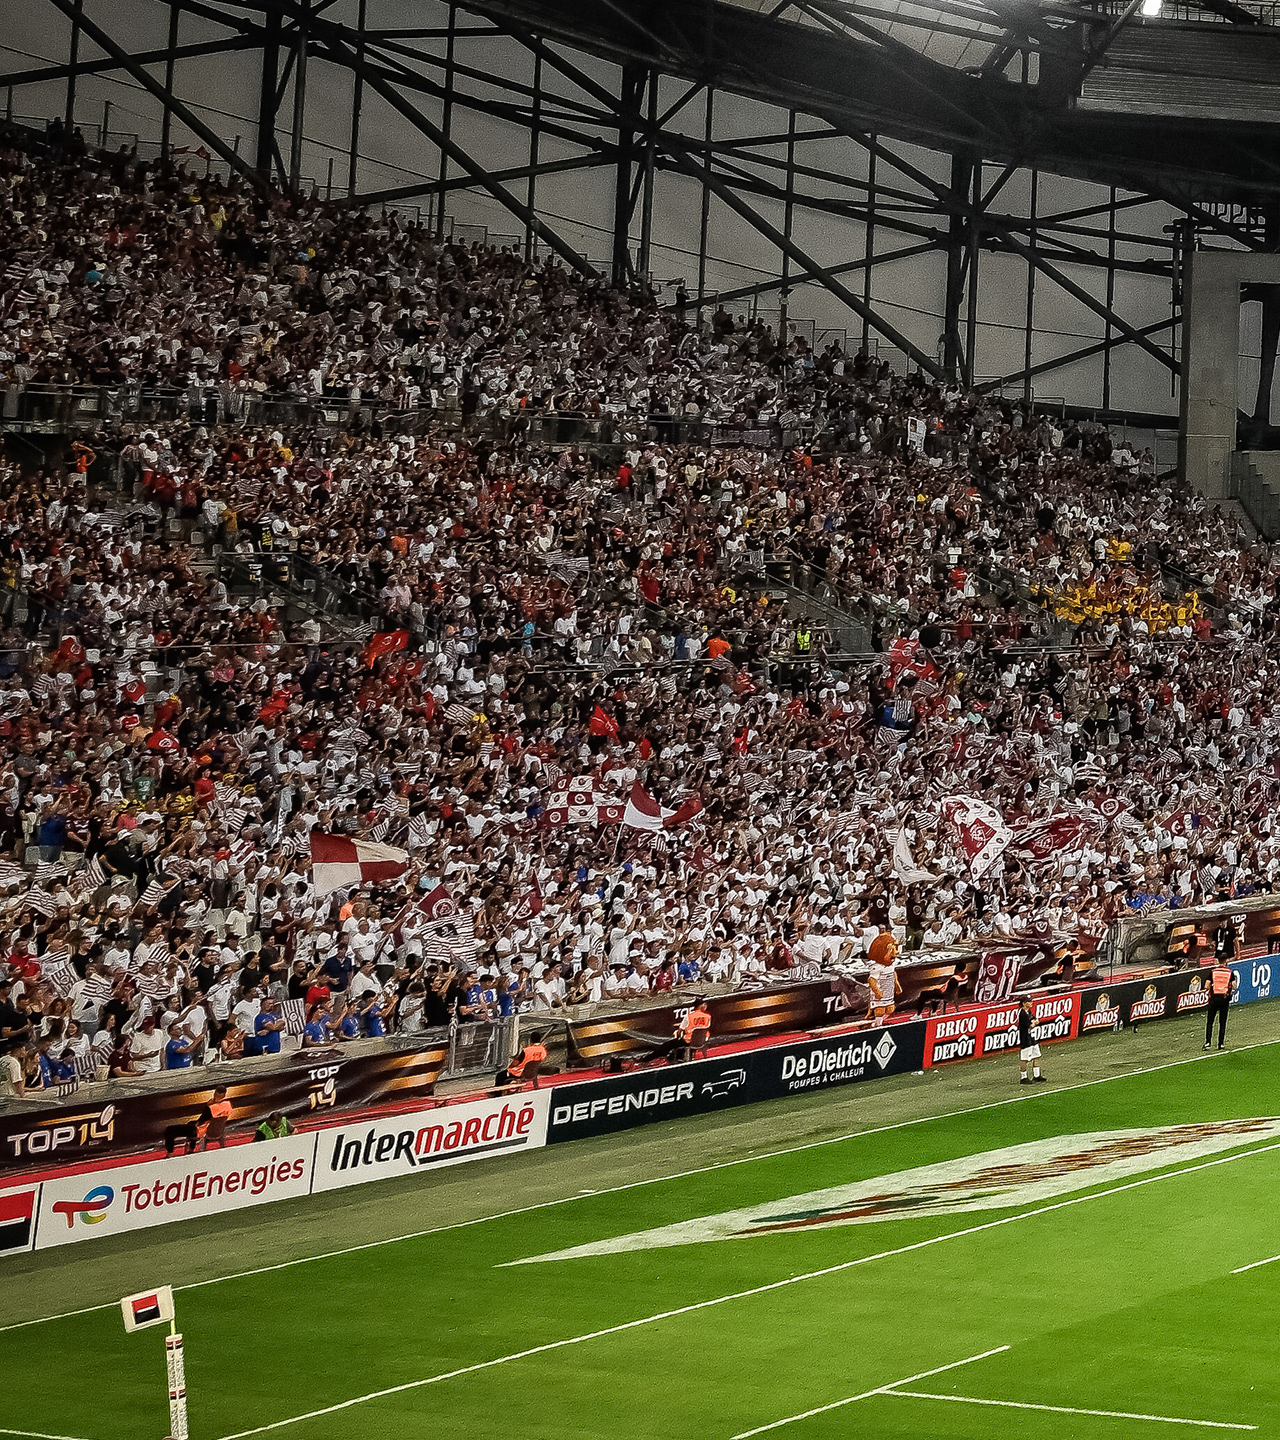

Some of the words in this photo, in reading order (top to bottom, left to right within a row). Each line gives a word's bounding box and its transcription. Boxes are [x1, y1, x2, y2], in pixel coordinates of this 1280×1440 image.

[1230, 914, 1247, 924] TOP
[1035, 998, 1073, 1020] BRICO
[1130, 999, 1166, 1018] ANDROS
[1178, 989, 1210, 1008] ANDROS
[934, 1016, 978, 1040] BRICO
[1083, 1008, 1118, 1028] ANDROS
[781, 1054, 806, 1080] De
[808, 1040, 872, 1075] Dietrich
[932, 1034, 976, 1062] DEPÔT
[308, 1066, 340, 1080] TOP
[789, 1076, 821, 1090] POMPES
[829, 1066, 864, 1082] CHALEUR
[552, 1082, 694, 1126] DEFENDER
[7, 1120, 116, 1157] TOP14
[330, 1102, 535, 1171] Intermarché
[120, 1156, 305, 1214] TotalEnergies
